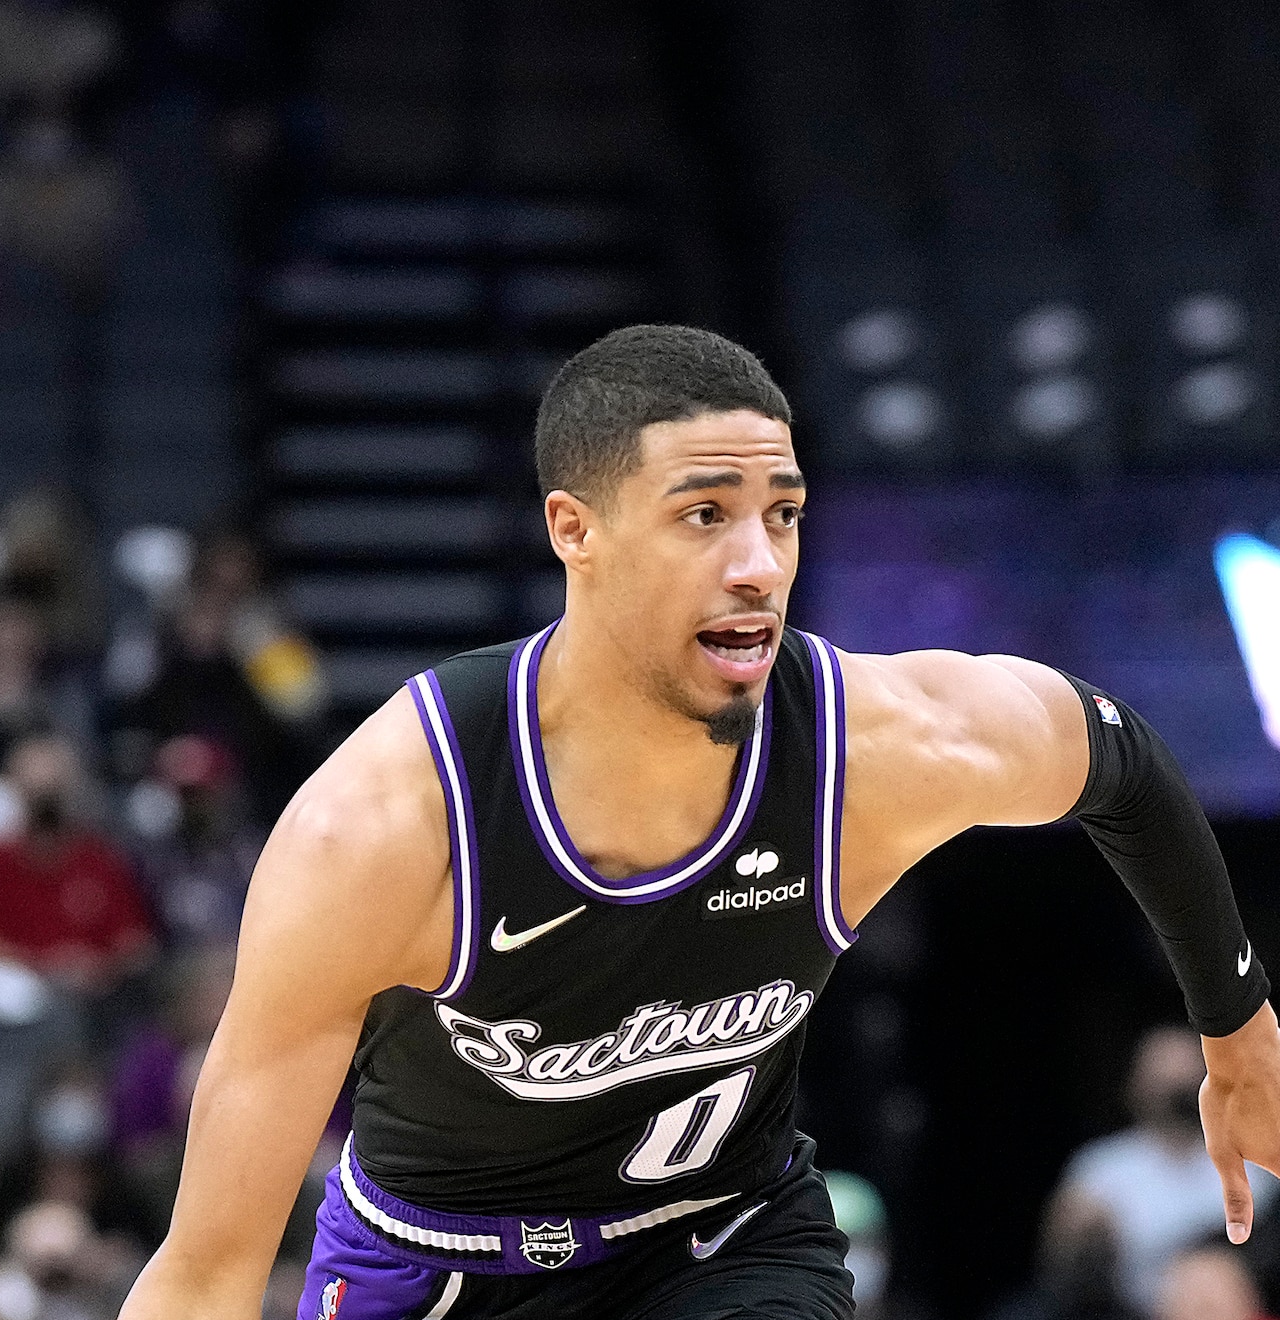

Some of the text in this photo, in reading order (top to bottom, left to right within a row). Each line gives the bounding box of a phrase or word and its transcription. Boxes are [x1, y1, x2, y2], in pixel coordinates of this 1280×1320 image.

[707, 876, 806, 911] dialpad
[434, 979, 814, 1100] Sactown
[619, 1065, 757, 1184] 0
